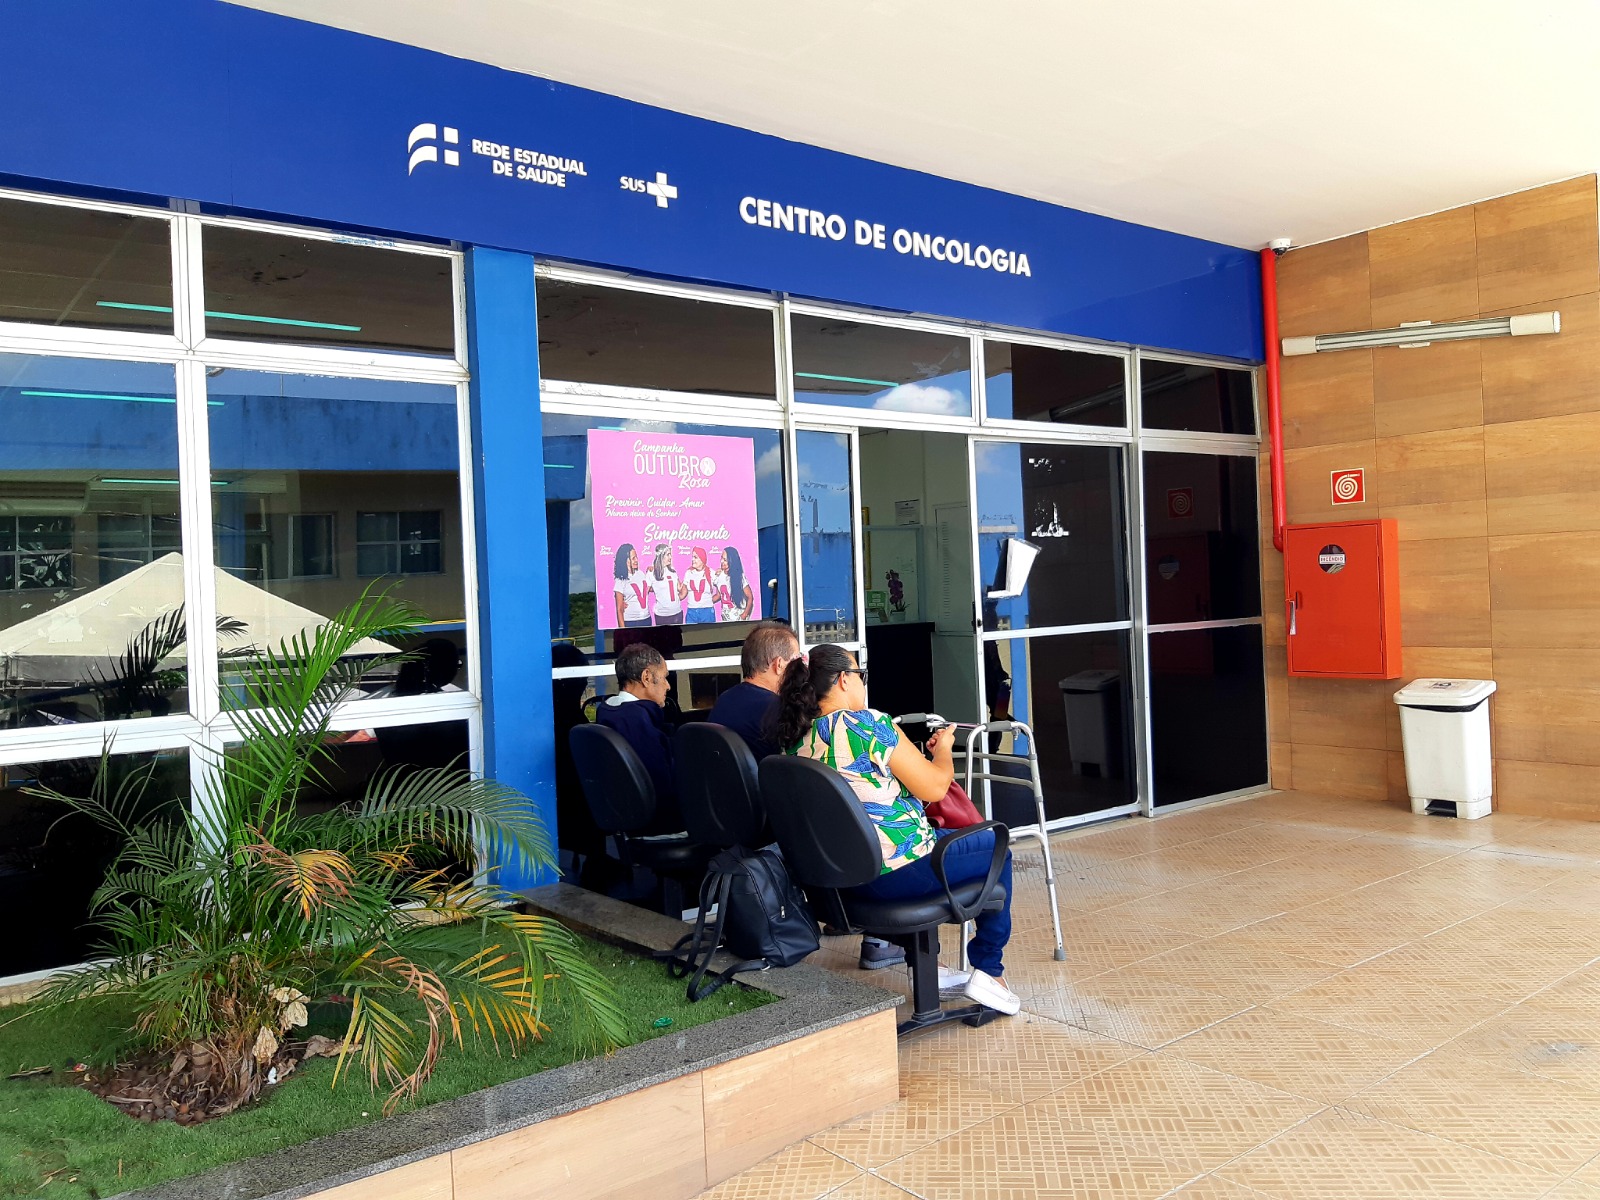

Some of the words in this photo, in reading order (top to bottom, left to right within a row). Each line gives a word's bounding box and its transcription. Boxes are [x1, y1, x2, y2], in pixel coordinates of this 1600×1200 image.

[472, 138, 510, 160] REDE
[514, 148, 587, 176] ESTADUAL
[492, 160, 513, 177] DE
[516, 165, 566, 188] SAUDE
[619, 175, 646, 193] SUS
[739, 196, 847, 241] CENTRO
[854, 218, 886, 250] DE
[892, 228, 1032, 277] ONCOLOGIA
[633, 439, 686, 455] Campanha
[677, 471, 711, 490] Rosa
[679, 497, 705, 508] Amar
[644, 522, 731, 545] Simplismente
